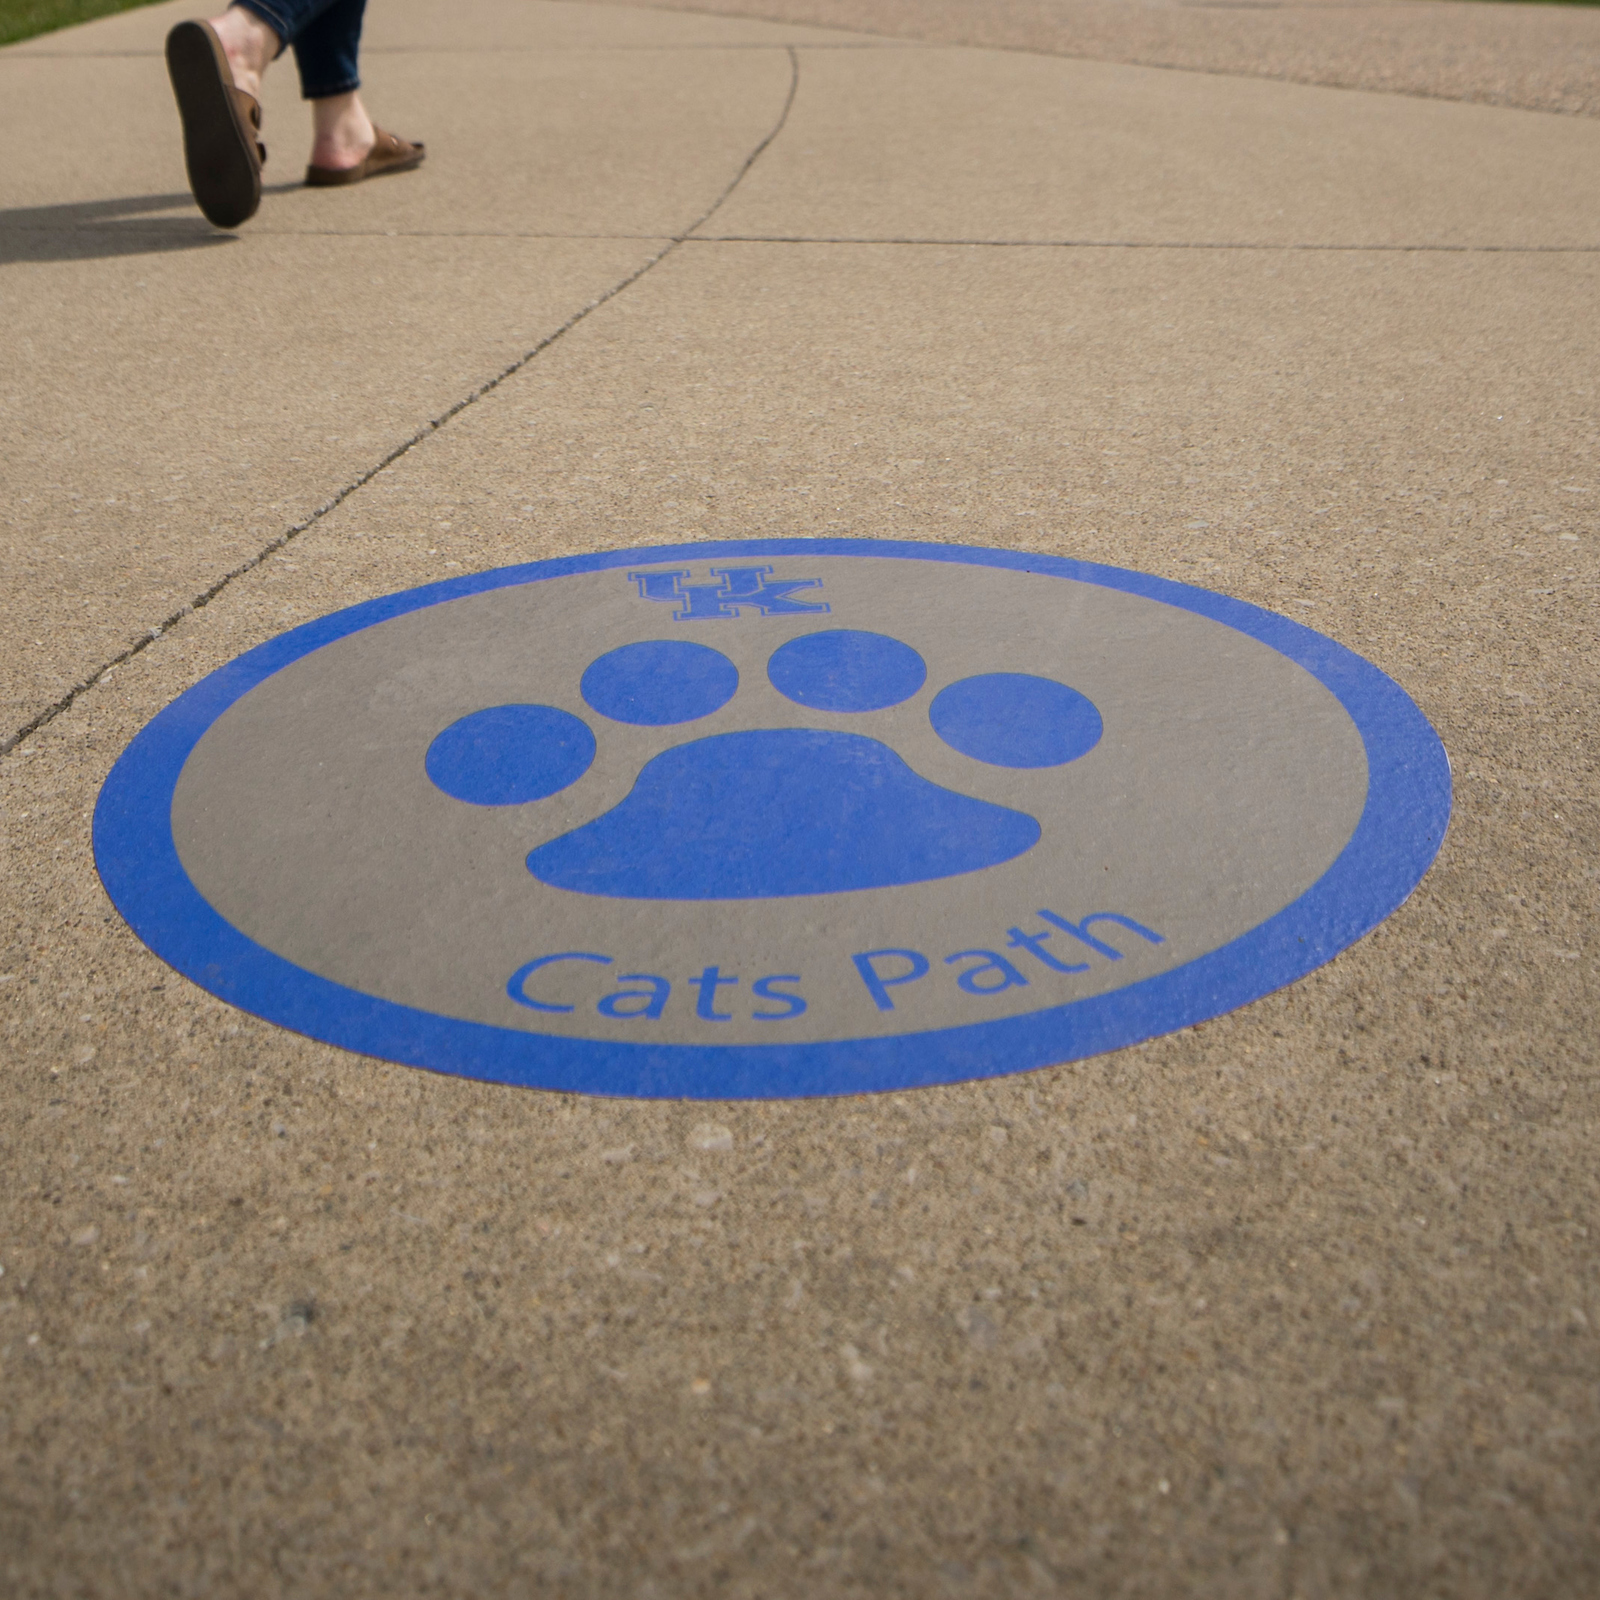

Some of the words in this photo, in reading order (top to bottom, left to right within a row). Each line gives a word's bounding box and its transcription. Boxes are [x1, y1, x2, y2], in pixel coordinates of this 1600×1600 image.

[627, 564, 832, 622] UK
[506, 952, 808, 1022] Cats
[850, 908, 1166, 1012] Path
